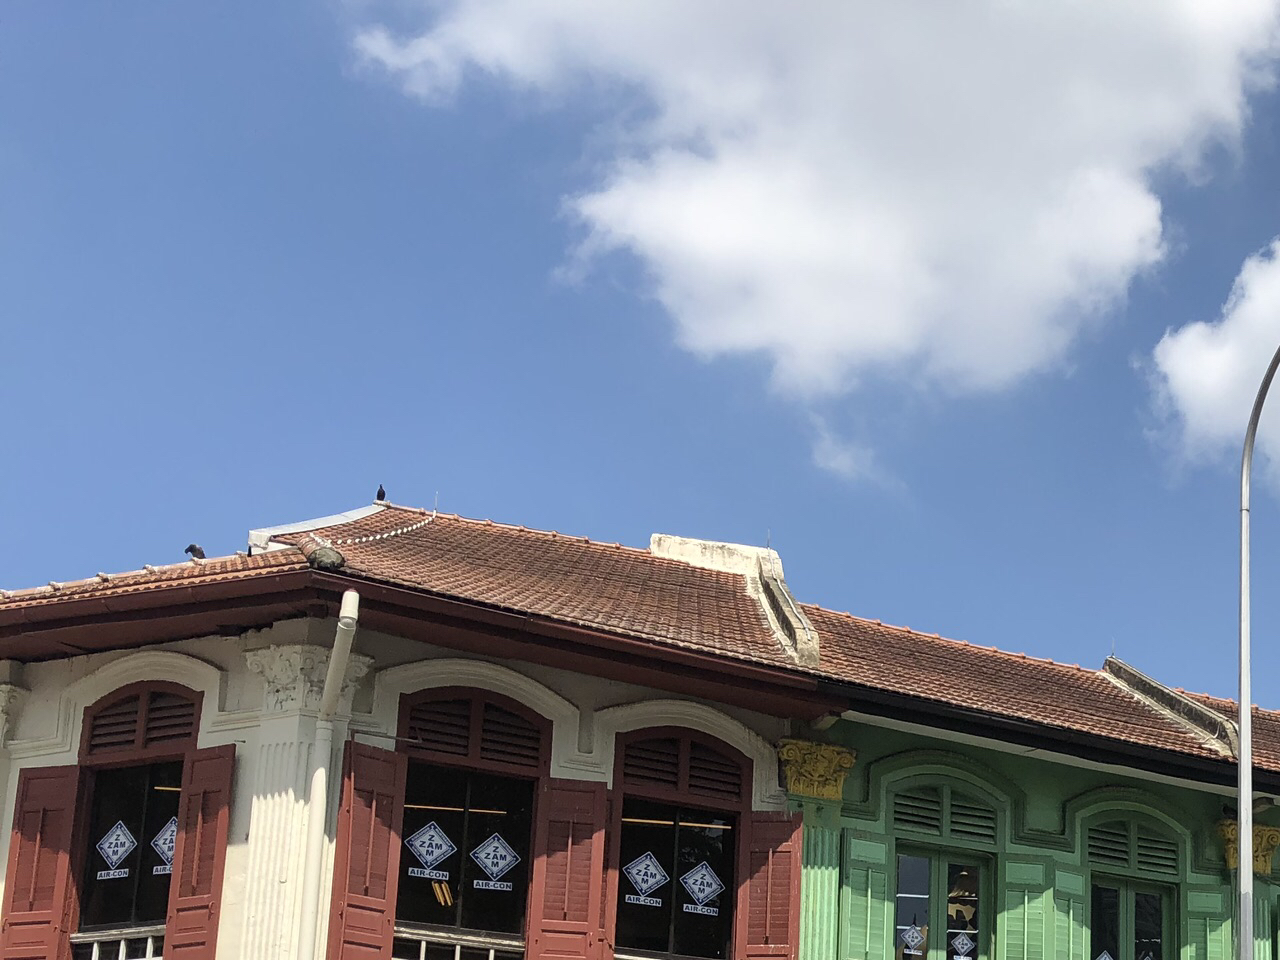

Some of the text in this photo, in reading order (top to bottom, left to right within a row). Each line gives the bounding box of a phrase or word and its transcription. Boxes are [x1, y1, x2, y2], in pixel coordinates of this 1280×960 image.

[98, 870, 128, 879] AIR-CON
[410, 869, 448, 879] AIR-CON
[475, 881, 512, 889] AIR-CON
[627, 896, 661, 905] AIR-CON
[685, 905, 718, 915] AIR-CON
